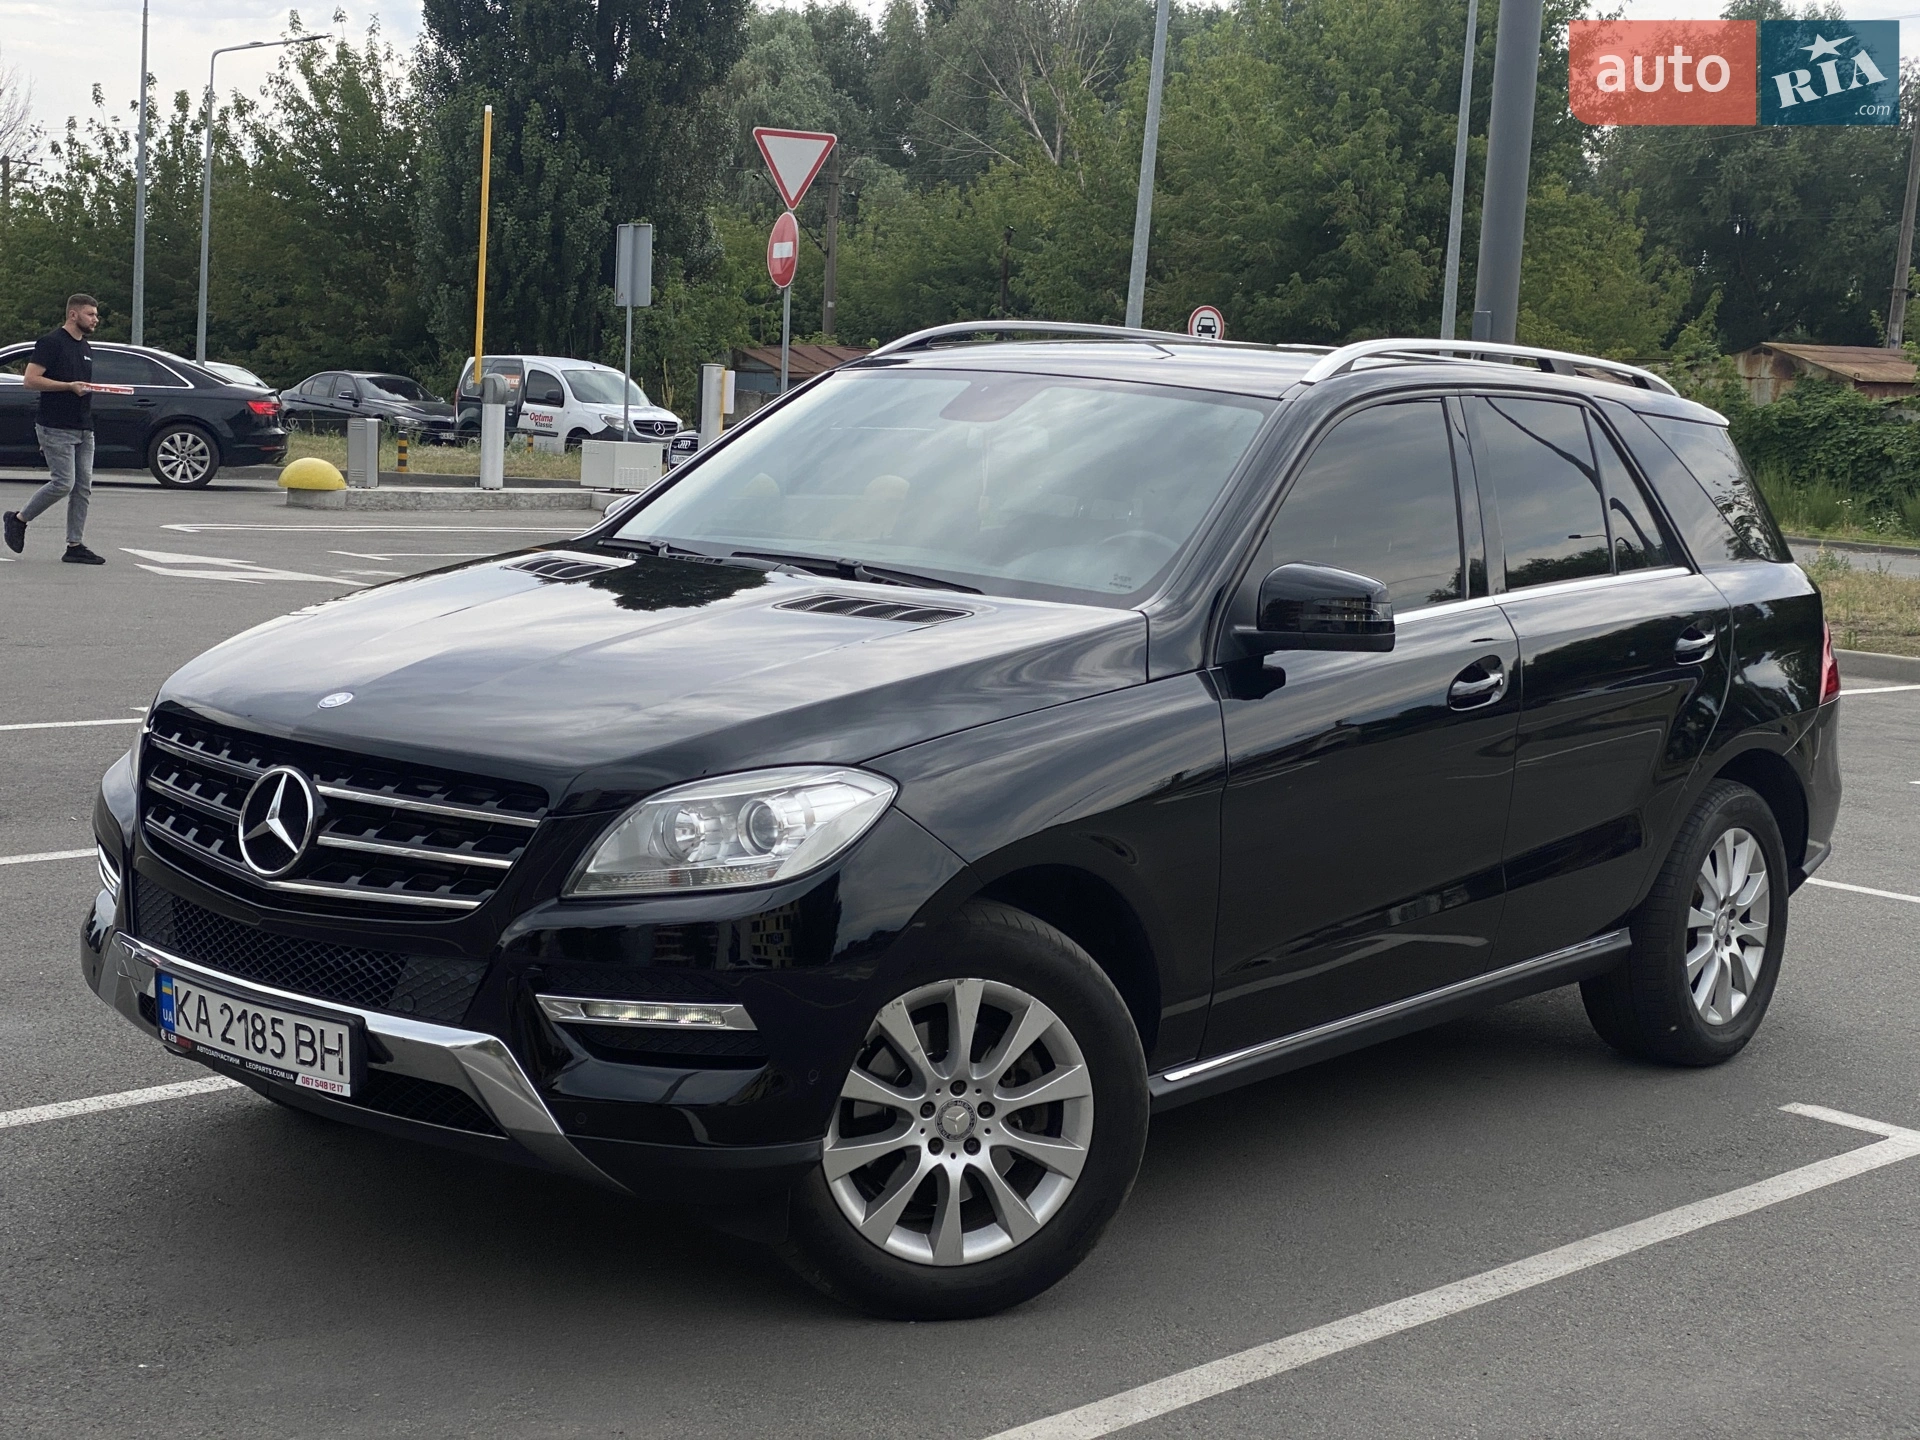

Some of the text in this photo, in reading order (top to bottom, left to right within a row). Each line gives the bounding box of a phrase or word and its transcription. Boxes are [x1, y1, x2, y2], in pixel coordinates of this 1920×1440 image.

[530, 412, 553, 422] Optima
[162, 1008, 174, 1024] UA
[219, 1002, 286, 1060] 2185
[245, 1061, 294, 1081] LEOPARTS.COM.UA
[301, 1076, 313, 1086] 067
